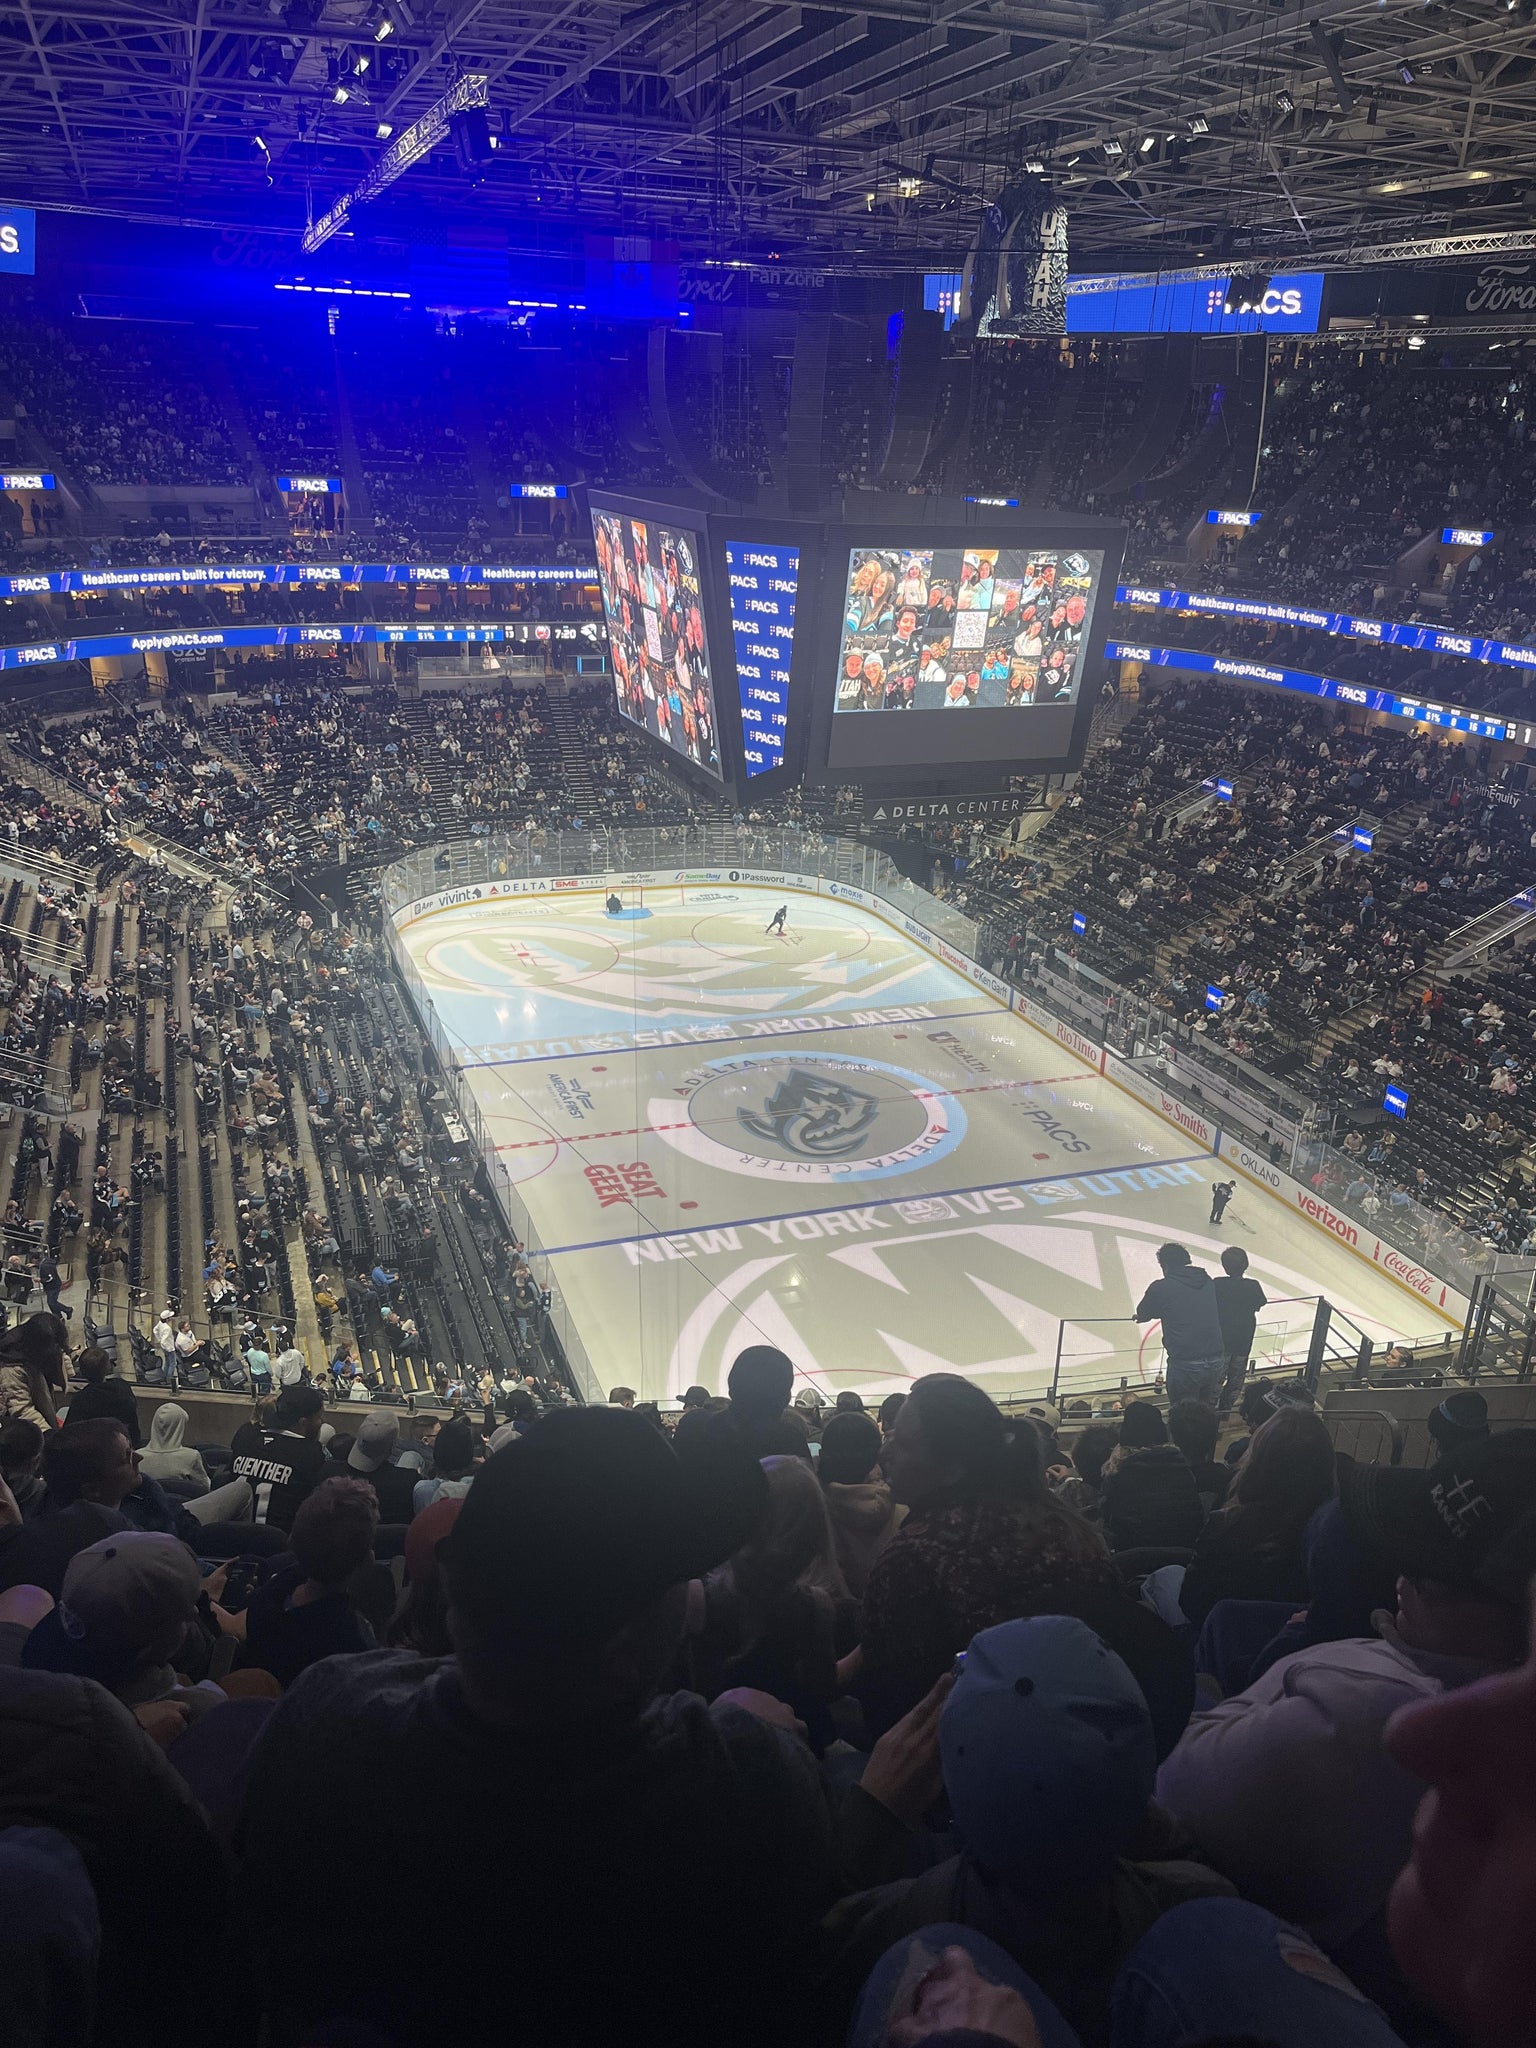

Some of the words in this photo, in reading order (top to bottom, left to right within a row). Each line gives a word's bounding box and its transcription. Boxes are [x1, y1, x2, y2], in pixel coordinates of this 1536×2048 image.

[1032, 212, 1058, 307] UTAH
[784, 270, 825, 288] Zone
[82, 570, 139, 586] Healthcare
[140, 570, 181, 583] careers
[182, 568, 207, 581] built
[208, 567, 225, 580] for
[226, 566, 266, 582] victory.
[483, 568, 536, 579] Healthcare
[538, 570, 574, 579] careers
[576, 568, 598, 579] built
[1189, 595, 1234, 611] Healthcare
[1235, 604, 1267, 616] careers
[1268, 606, 1285, 618] built
[1286, 608, 1299, 621] for
[132, 633, 223, 650] Apply@PACS.com
[555, 629, 576, 640] 7:20
[1213, 660, 1283, 682] Apply@PACS.com
[893, 804, 949, 818] DELTA
[956, 799, 1019, 814] CENTER
[503, 882, 546, 893] DELTA
[555, 880, 578, 888] SME
[742, 873, 785, 884] 1Password
[840, 886, 864, 900] moxie
[905, 918, 916, 933] BUD
[915, 926, 931, 944] LIGHT
[978, 972, 991, 986] Ken
[991, 979, 1008, 998] Garff
[950, 1037, 991, 1074] HEALTH
[684, 1059, 757, 1087] DELTA
[548, 1073, 572, 1103] AMERICA
[565, 1098, 584, 1120] FIRST
[1025, 1111, 1091, 1153] PACS
[1174, 1103, 1208, 1141] Smith's
[739, 1154, 852, 1174] CENTER
[869, 1135, 943, 1167] DELTA
[617, 1161, 667, 1199] SEAT
[1240, 1153, 1280, 1188] OKLAND
[583, 1164, 634, 1208] GEEK
[620, 1227, 743, 1266] NEW
[751, 1206, 891, 1244] YORK
[950, 1187, 1025, 1215] VS
[1081, 1162, 1206, 1197] UTAH
[1297, 1191, 1358, 1246] verizon
[1384, 1250, 1436, 1296] Coca-Cola
[233, 1455, 293, 1485] GUENTHER
